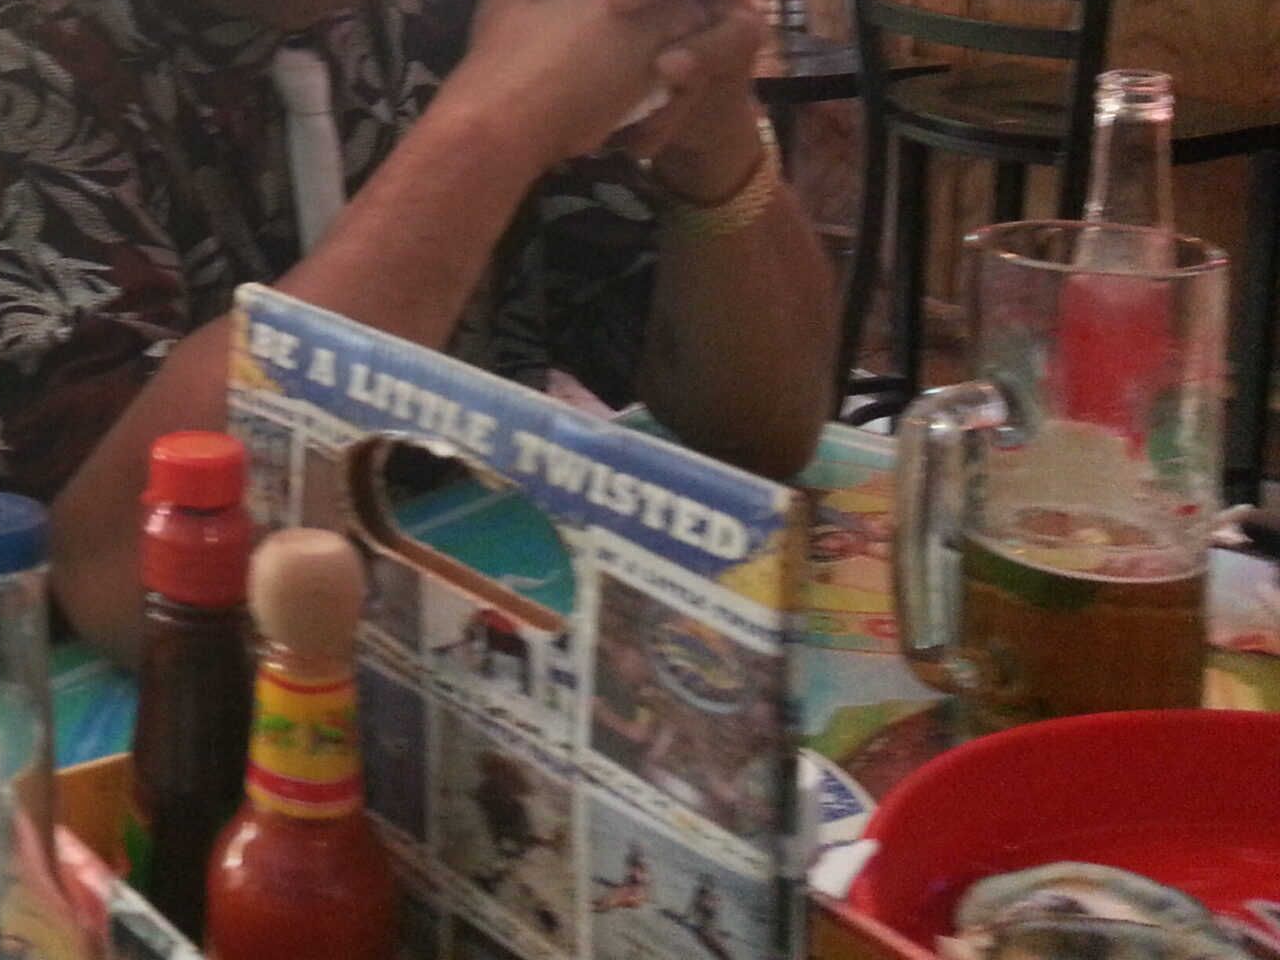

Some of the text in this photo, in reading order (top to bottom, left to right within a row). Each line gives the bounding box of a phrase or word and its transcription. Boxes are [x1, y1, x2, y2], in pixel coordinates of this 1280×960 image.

[249, 322, 301, 371] BE
[305, 346, 338, 388] A
[347, 362, 499, 456] LITTLE
[511, 429, 751, 561] TWISTED
